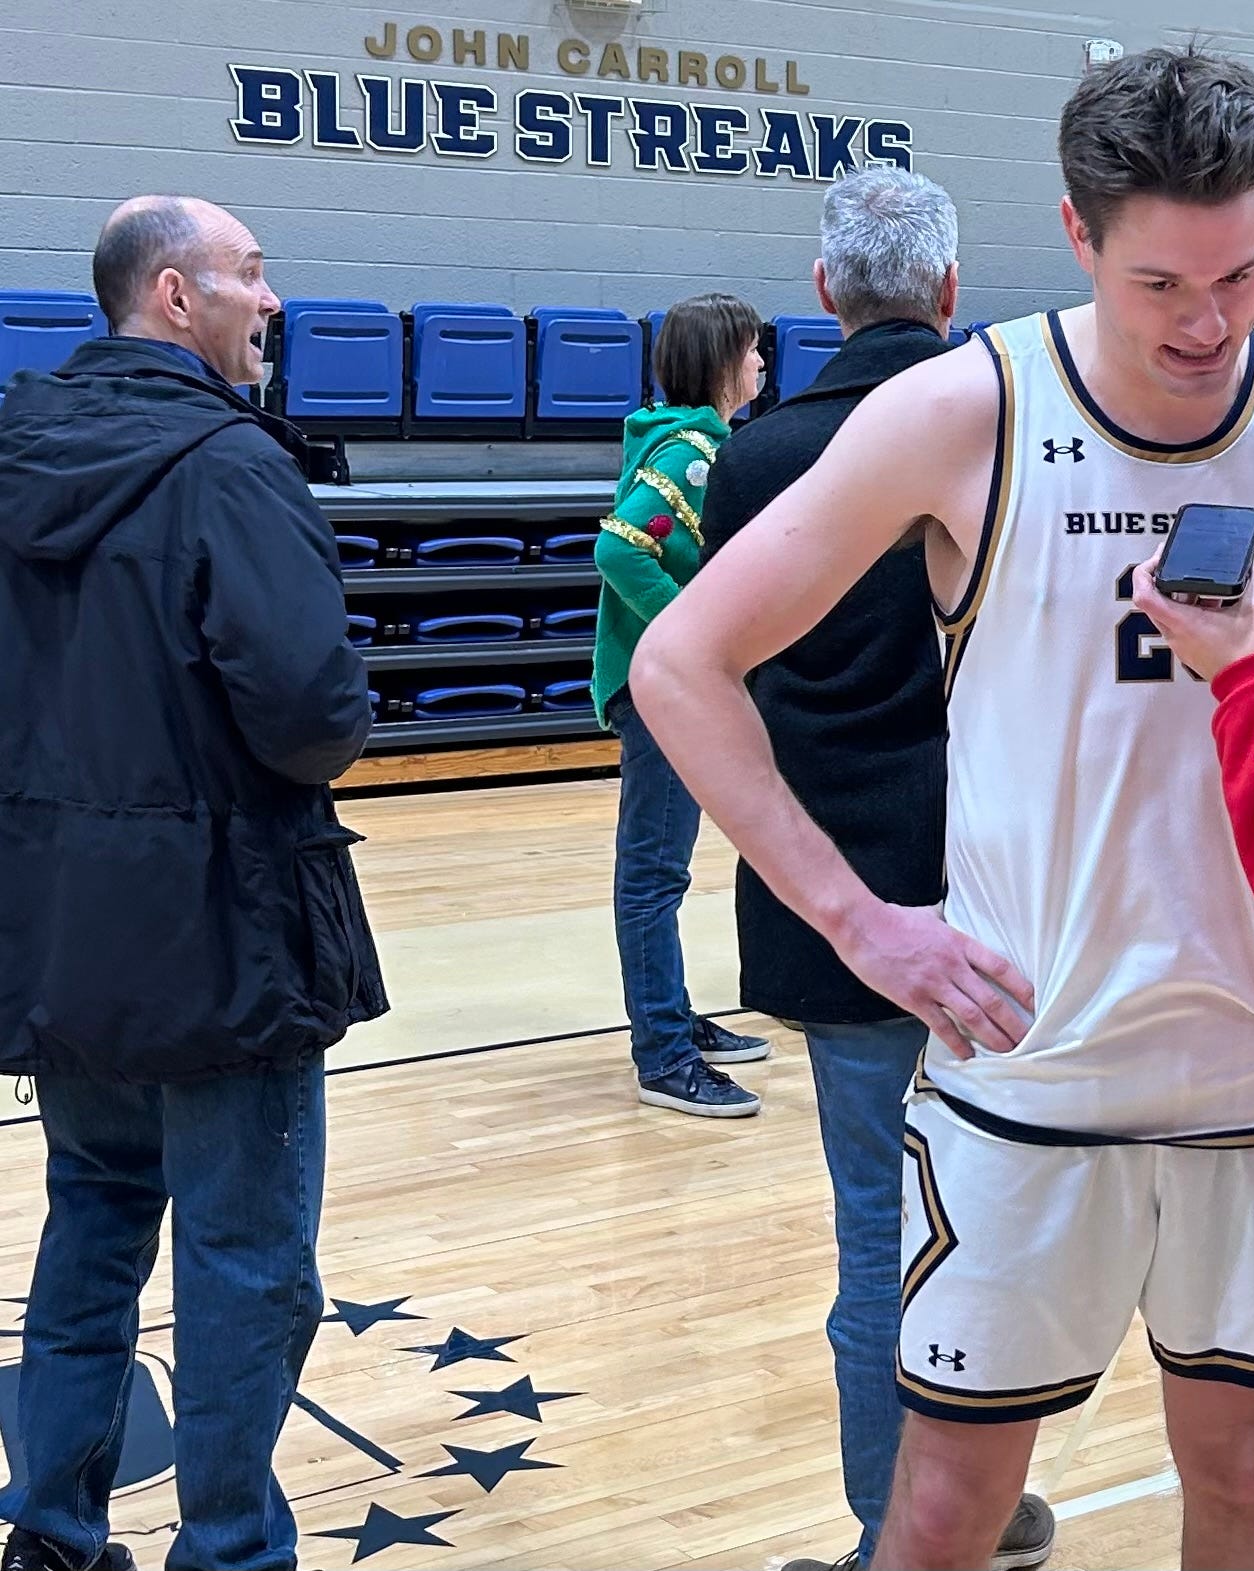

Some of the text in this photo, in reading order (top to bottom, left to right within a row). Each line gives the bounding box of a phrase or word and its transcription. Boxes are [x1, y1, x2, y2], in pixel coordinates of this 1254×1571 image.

[364, 22, 810, 95] JOHN CARROLL
[228, 63, 913, 182] BLUE STREAKS
[1065, 511, 1145, 535] BLUE
